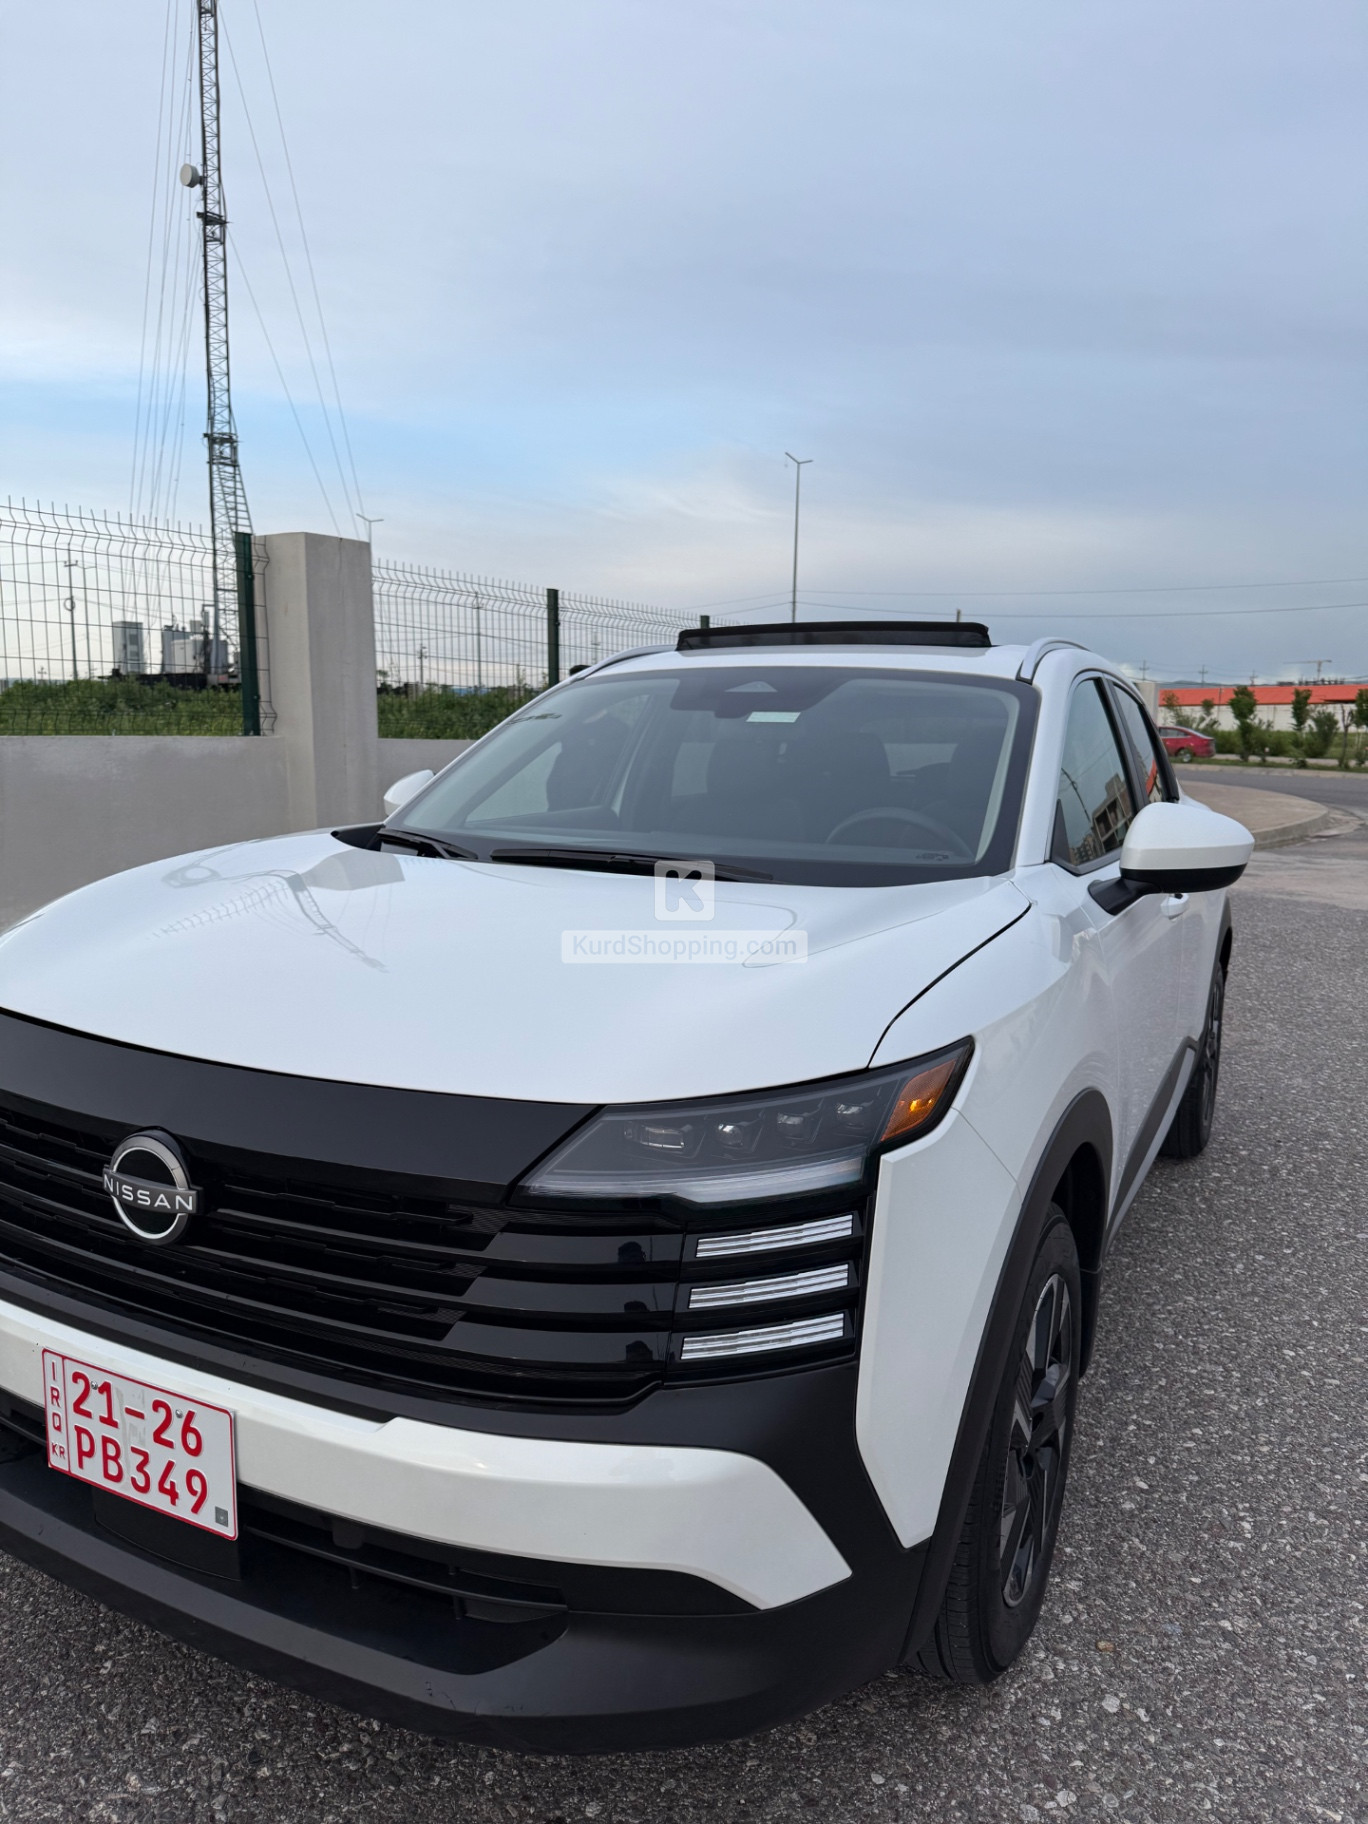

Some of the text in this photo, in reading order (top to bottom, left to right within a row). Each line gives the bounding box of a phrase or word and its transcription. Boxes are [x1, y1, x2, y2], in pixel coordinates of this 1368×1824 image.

[104, 1174, 193, 1210] NISSAN
[72, 1371, 203, 1457] 21-26
[51, 1442, 66, 1460] KR
[74, 1424, 208, 1514] PB349
